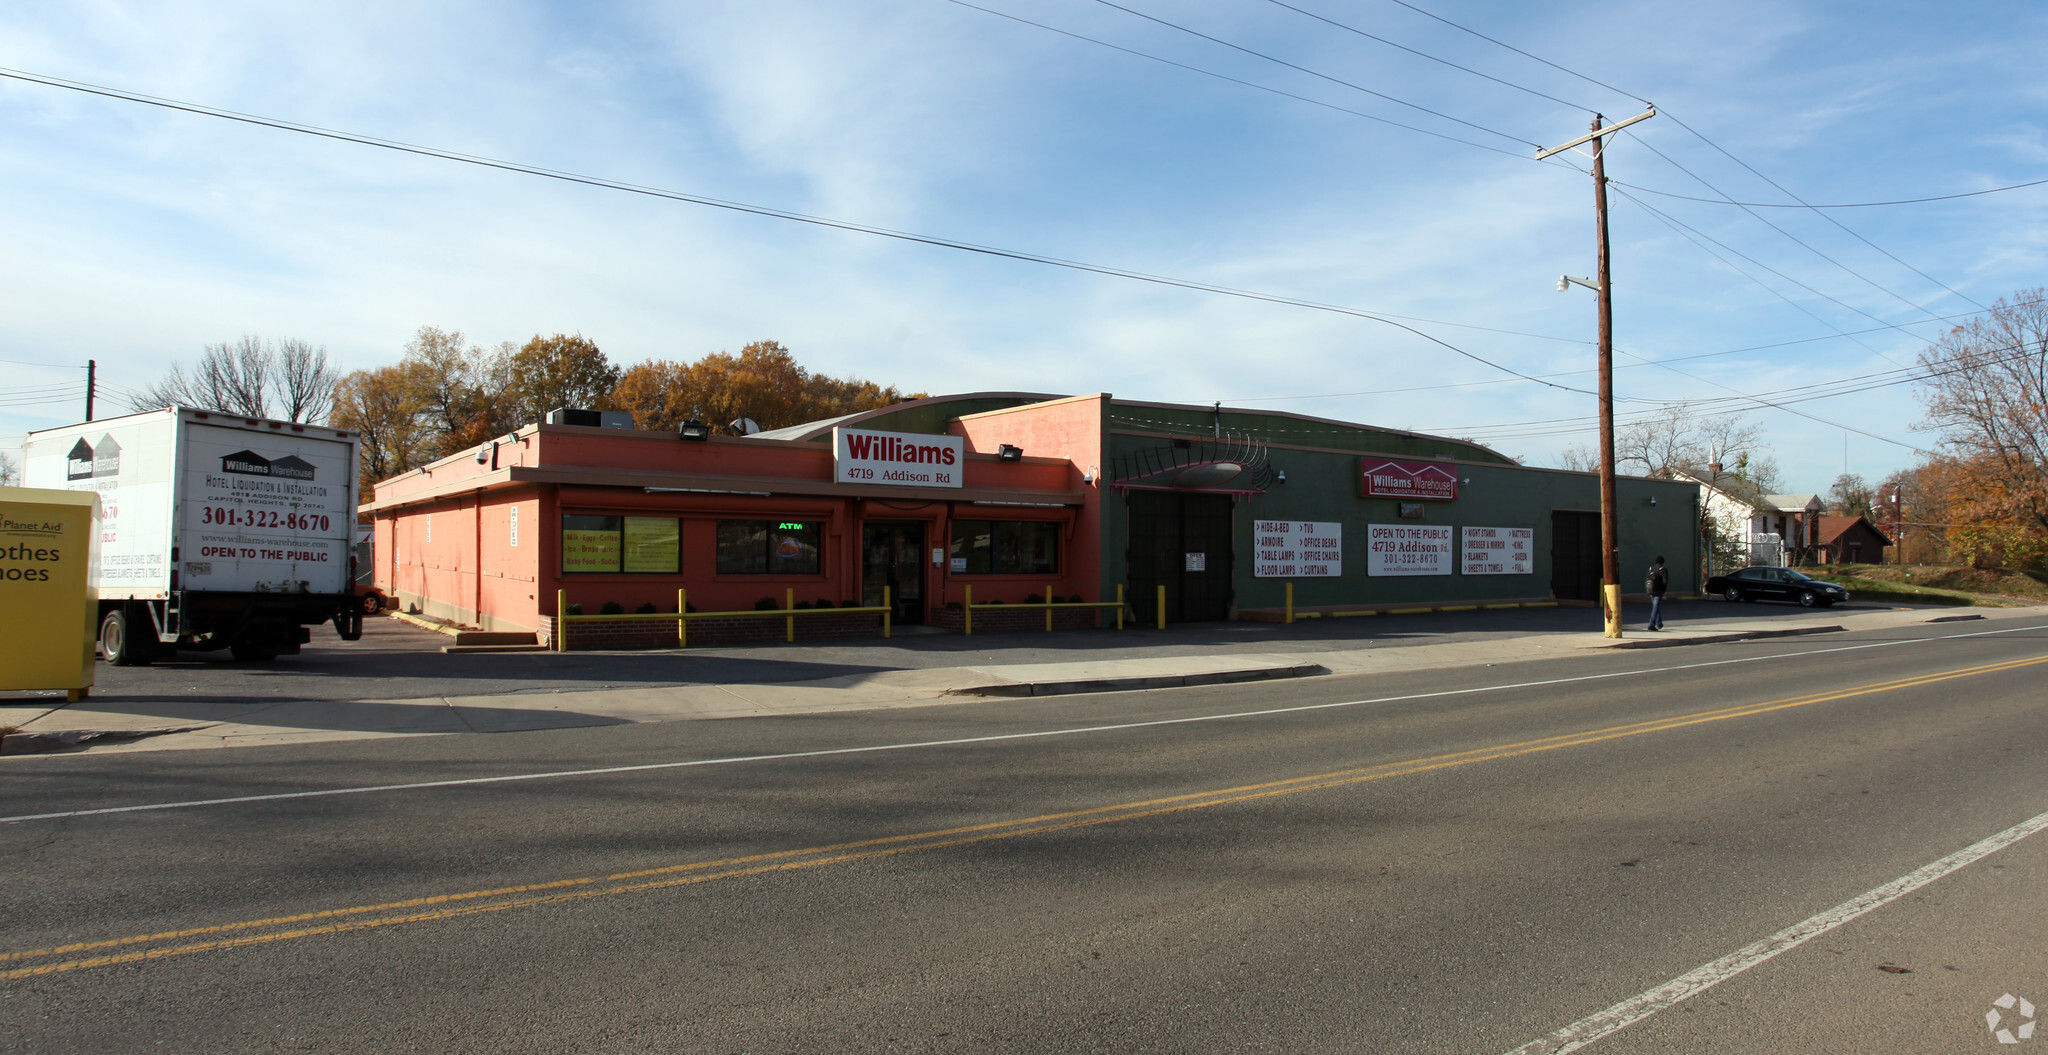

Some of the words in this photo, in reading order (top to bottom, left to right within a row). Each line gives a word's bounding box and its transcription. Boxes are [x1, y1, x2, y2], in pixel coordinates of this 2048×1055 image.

[847, 434, 955, 465] Williams
[226, 460, 269, 474] Williams
[271, 464, 313, 478] Warehouse
[847, 468, 873, 479] 4719
[882, 470, 930, 482] Addison
[935, 473, 950, 483] Rd
[206, 475, 229, 489] HOTEL
[232, 477, 275, 492] LIQUIDATION
[277, 483, 281, 492] &
[283, 482, 327, 497] INSTALLATION
[1373, 475, 1412, 488] Williams
[1414, 477, 1450, 490] Warehouse
[208, 495, 245, 504] CAPITOL
[252, 493, 289, 501] ADDISON
[101, 506, 118, 519] 670
[202, 506, 330, 531] 301-322-8670
[4, 520, 38, 529] Planet
[42, 522, 61, 531] Aid
[1261, 522, 1289, 533] HIDE-A-BED
[1304, 524, 1313, 533] TVS
[1372, 528, 1393, 539] OPEN
[1395, 529, 1405, 539] TO
[1407, 529, 1421, 539] THE
[1423, 530, 1448, 539] PUBLIC
[1468, 529, 1480, 537] NIGHT
[201, 535, 329, 549] www.williams-warehouse.com
[1261, 537, 1284, 547] ARMOIRE
[1304, 538, 1320, 548] OFFICE
[1322, 538, 1336, 548] DESKS
[1372, 541, 1395, 552] 4719
[1398, 541, 1437, 552] Addison
[201, 546, 236, 558] OPEN
[240, 548, 256, 558] TO
[260, 549, 283, 560] THE
[287, 550, 328, 562] PUBLIC
[1261, 550, 1277, 560] TABLE
[1278, 551, 1295, 560] LAMPS
[1304, 551, 1320, 561] OFFICE
[1322, 551, 1339, 561] CHAIRS
[1384, 554, 1438, 563] 301-322-8670
[1468, 552, 1488, 560] BLANKETS
[0, 568, 49, 581] oes
[1261, 565, 1278, 575] FLOOR
[1279, 565, 1295, 575] LAMPS
[1304, 565, 1327, 575] CURTAINS
